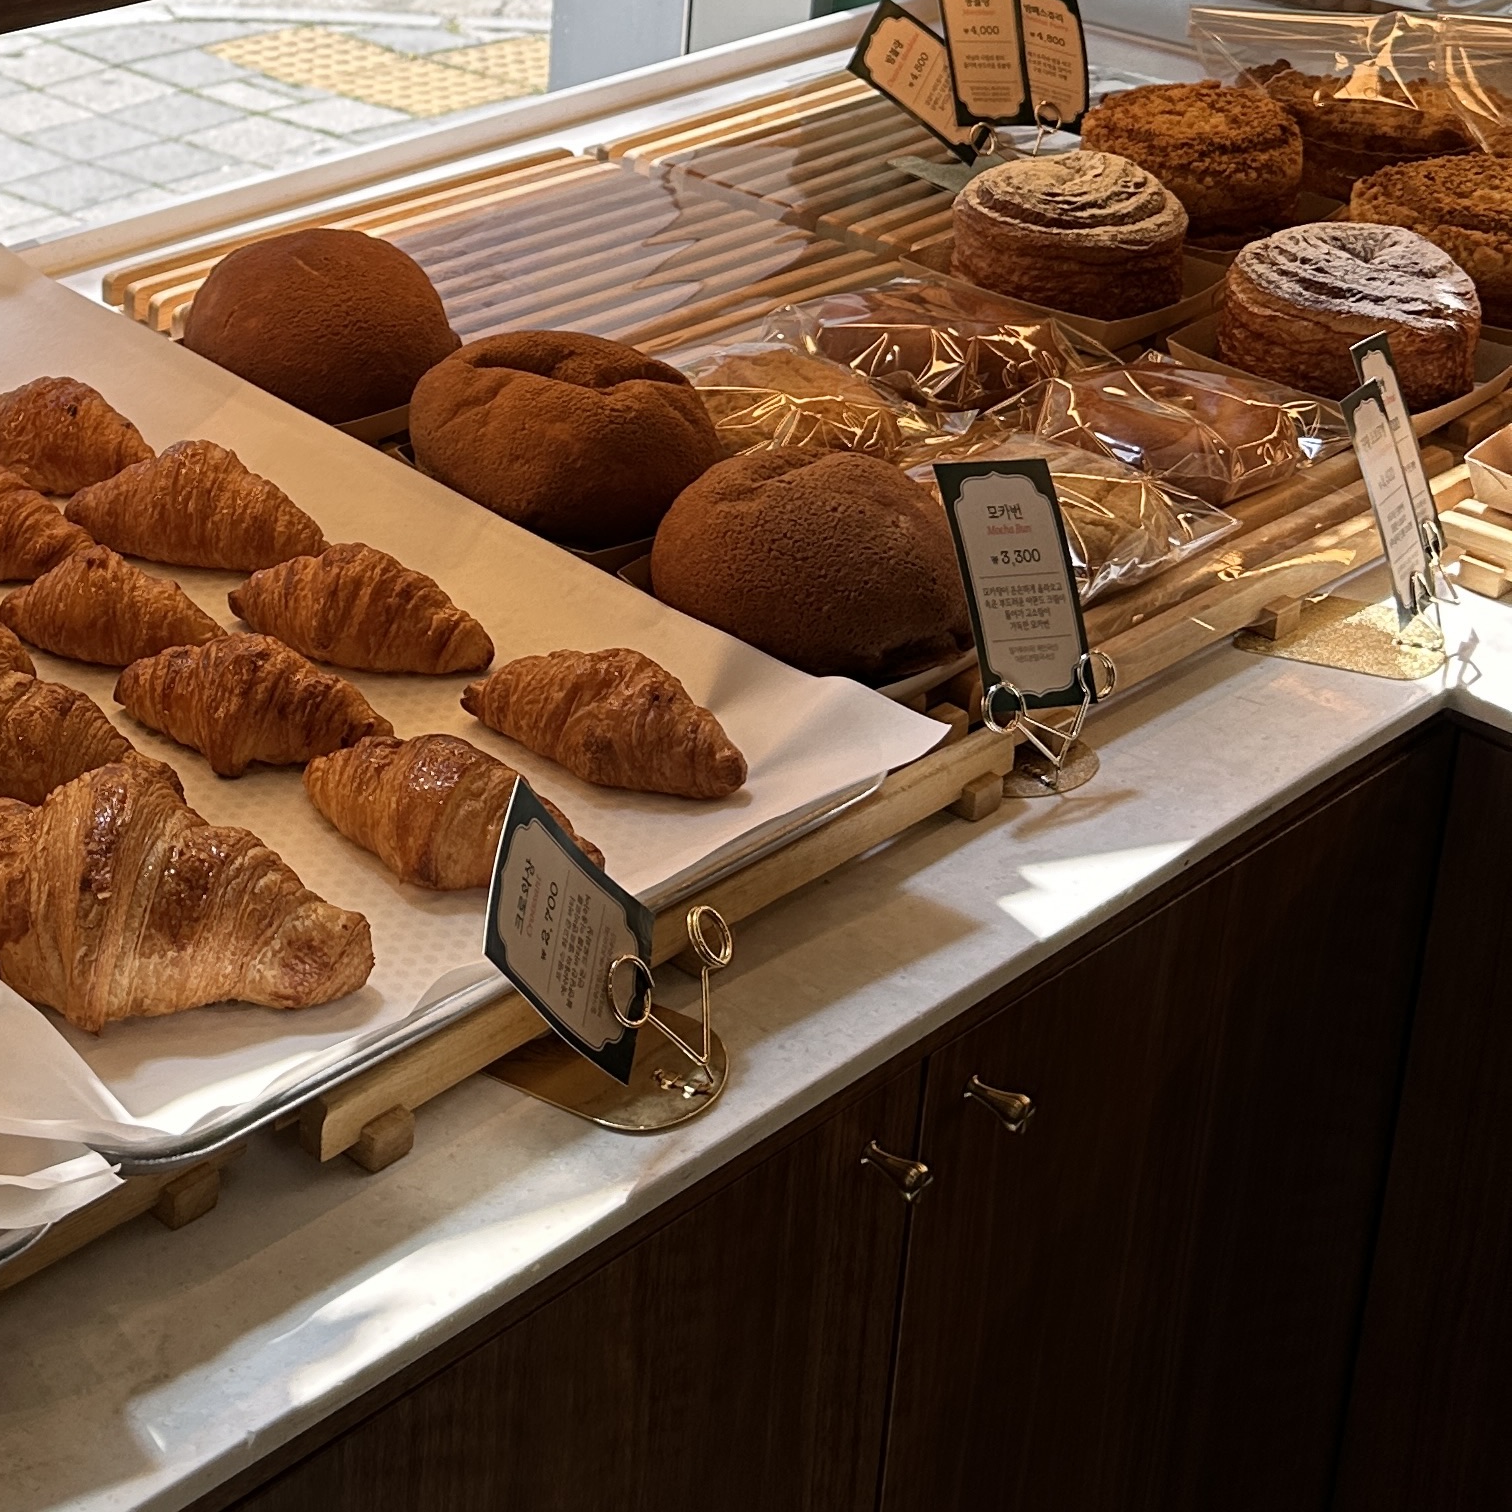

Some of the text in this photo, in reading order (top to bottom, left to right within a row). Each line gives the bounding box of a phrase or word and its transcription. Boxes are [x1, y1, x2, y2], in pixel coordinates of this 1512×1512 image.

[970, 25, 1000, 37] 4,000
[986, 503, 1024, 521] 모카번
[987, 523, 1033, 536] Mocha Bun
[1000, 548, 1041, 567] 3,300
[514, 858, 535, 935] 크로와상
